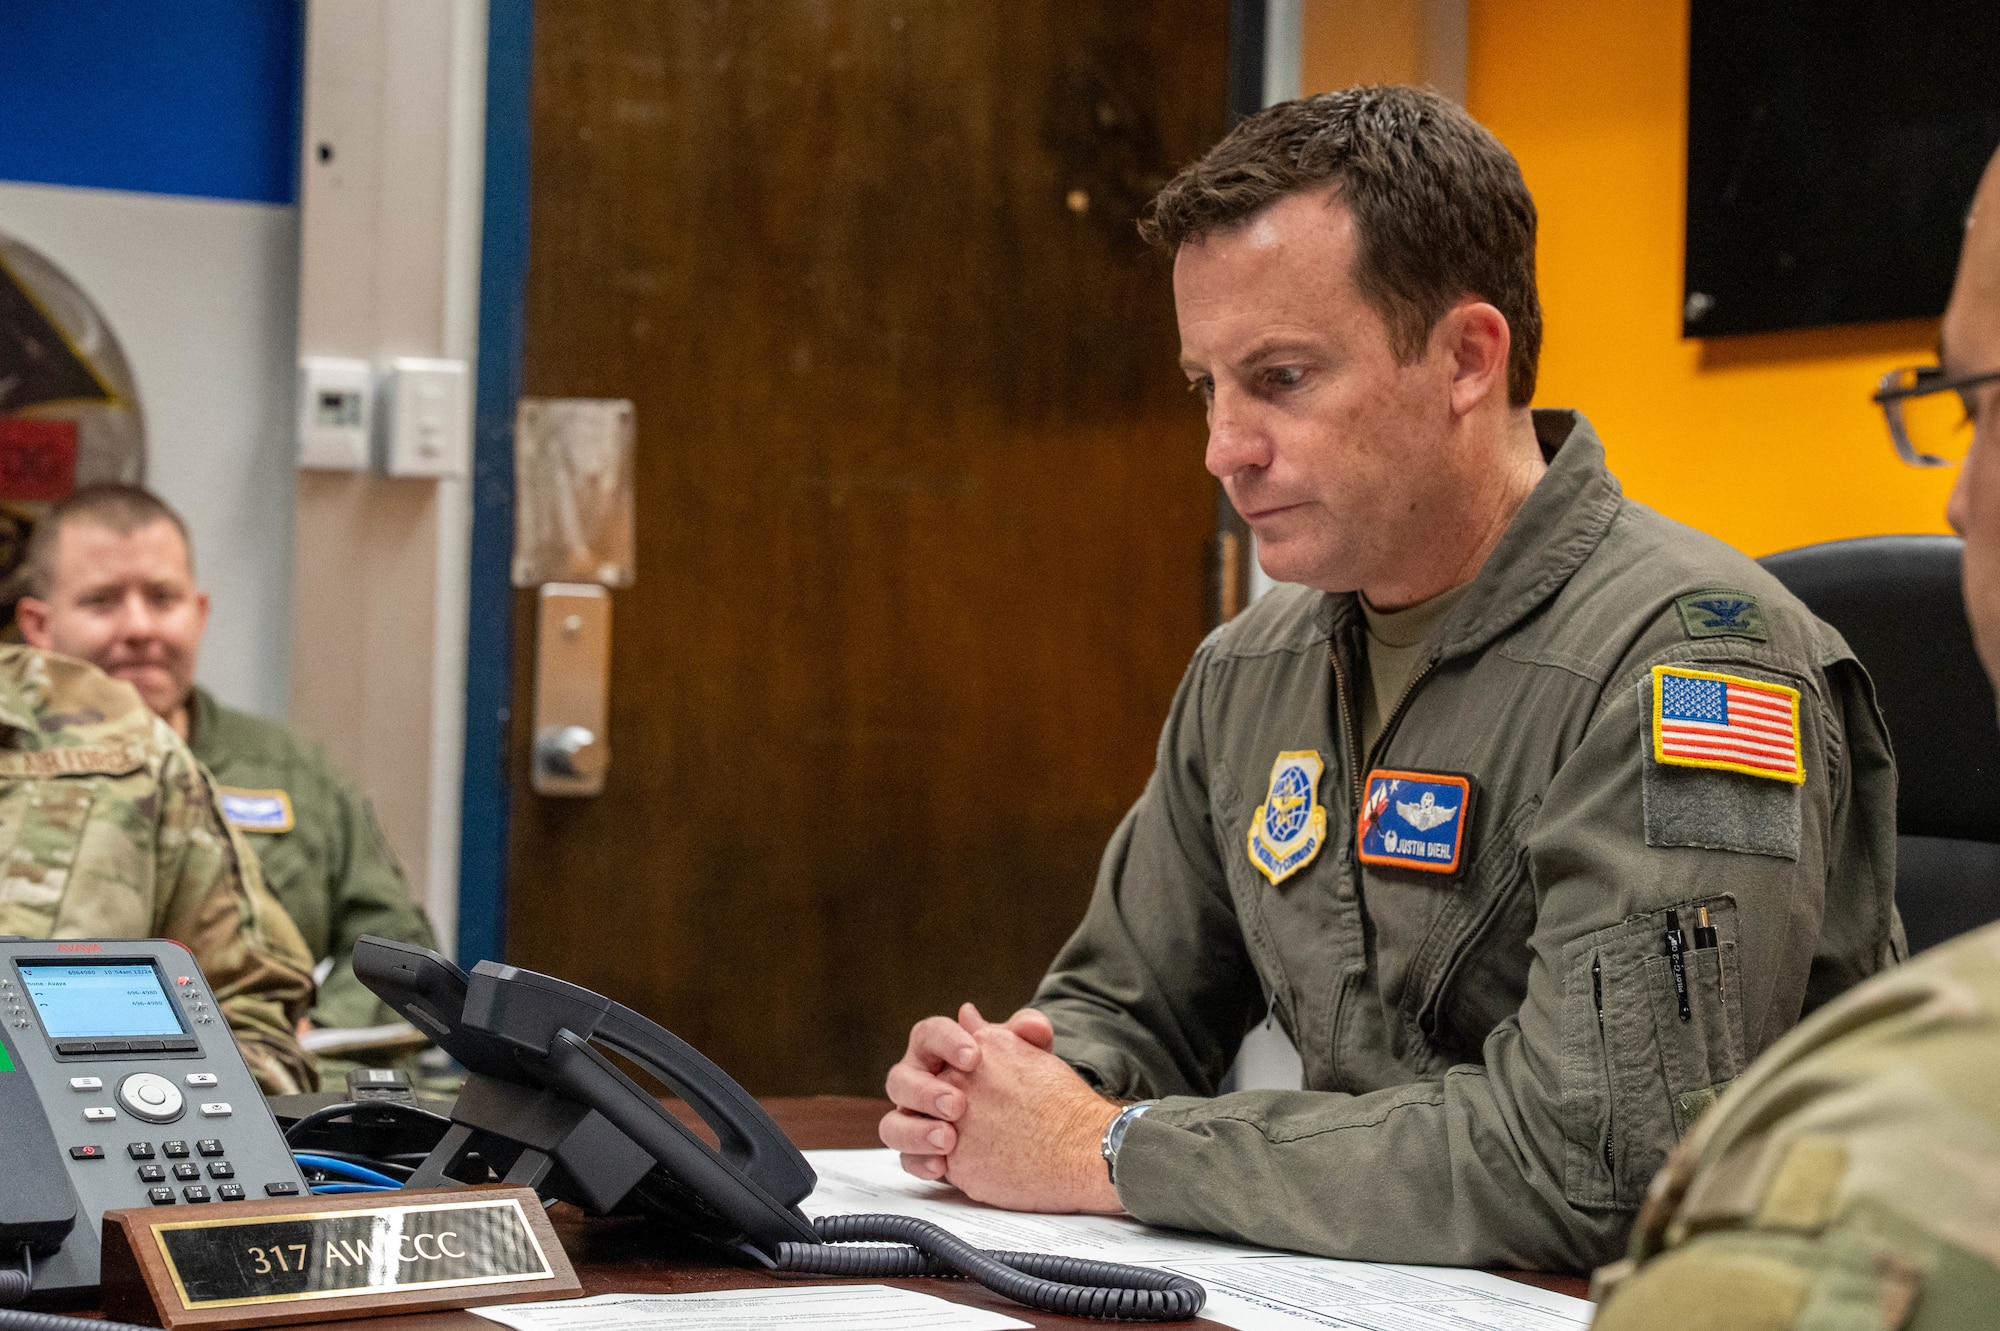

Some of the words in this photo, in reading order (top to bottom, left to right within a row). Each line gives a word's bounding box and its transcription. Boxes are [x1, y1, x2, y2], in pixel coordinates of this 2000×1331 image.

[1396, 838, 1426, 857] JUSTIN
[1427, 842, 1452, 860] DIEHL
[57, 943, 104, 954] AVAYA
[1671, 953, 1681, 972] G-2
[1675, 973, 1684, 993] PILOT
[247, 1243, 307, 1274] 317
